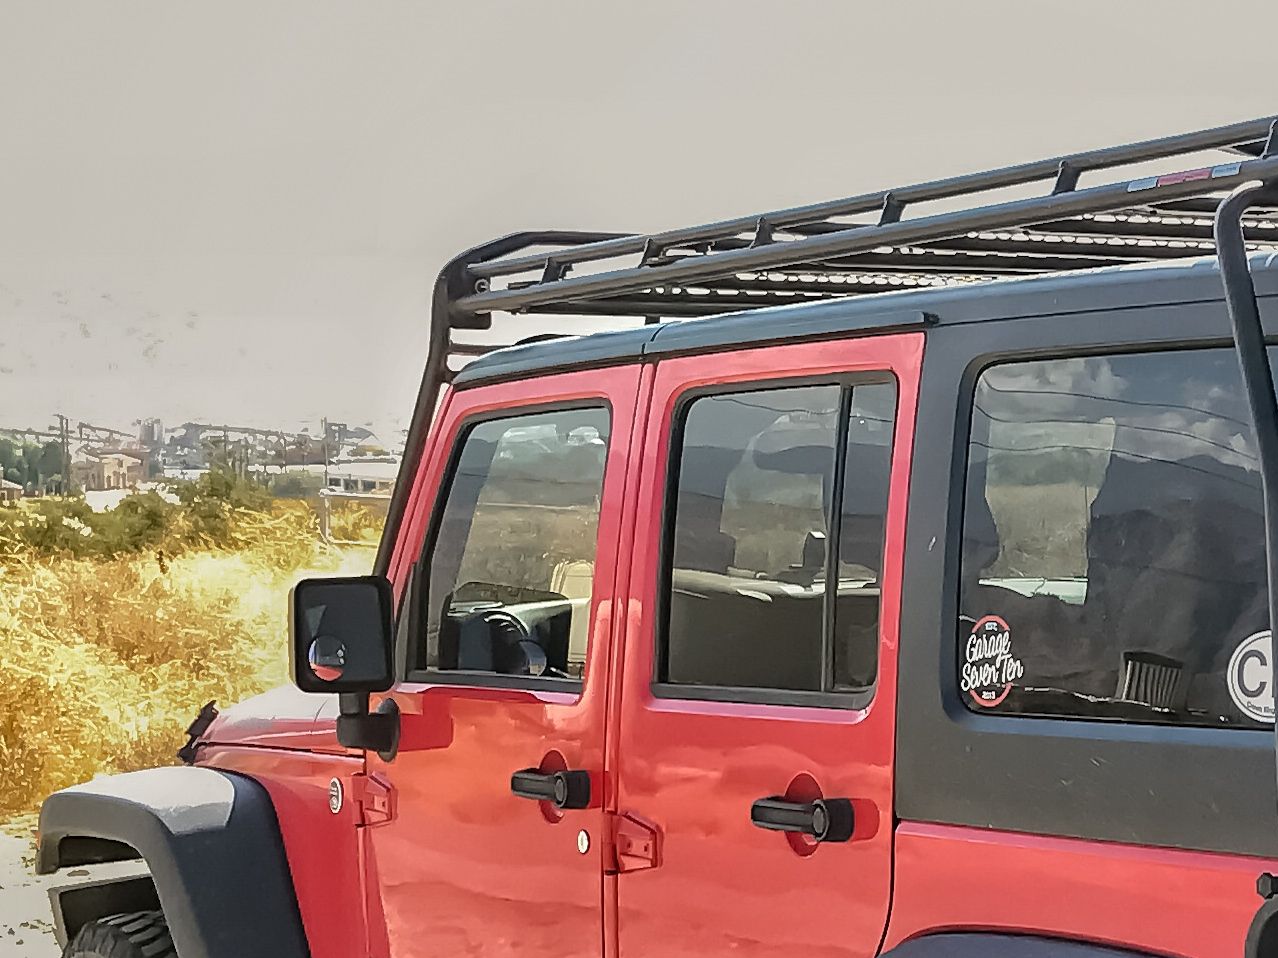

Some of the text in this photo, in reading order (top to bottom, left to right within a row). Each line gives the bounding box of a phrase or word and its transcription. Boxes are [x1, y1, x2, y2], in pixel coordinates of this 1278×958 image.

[966, 631, 1012, 668] Garage
[960, 653, 1024, 692] Seven Ten
[1238, 650, 1276, 698] C
